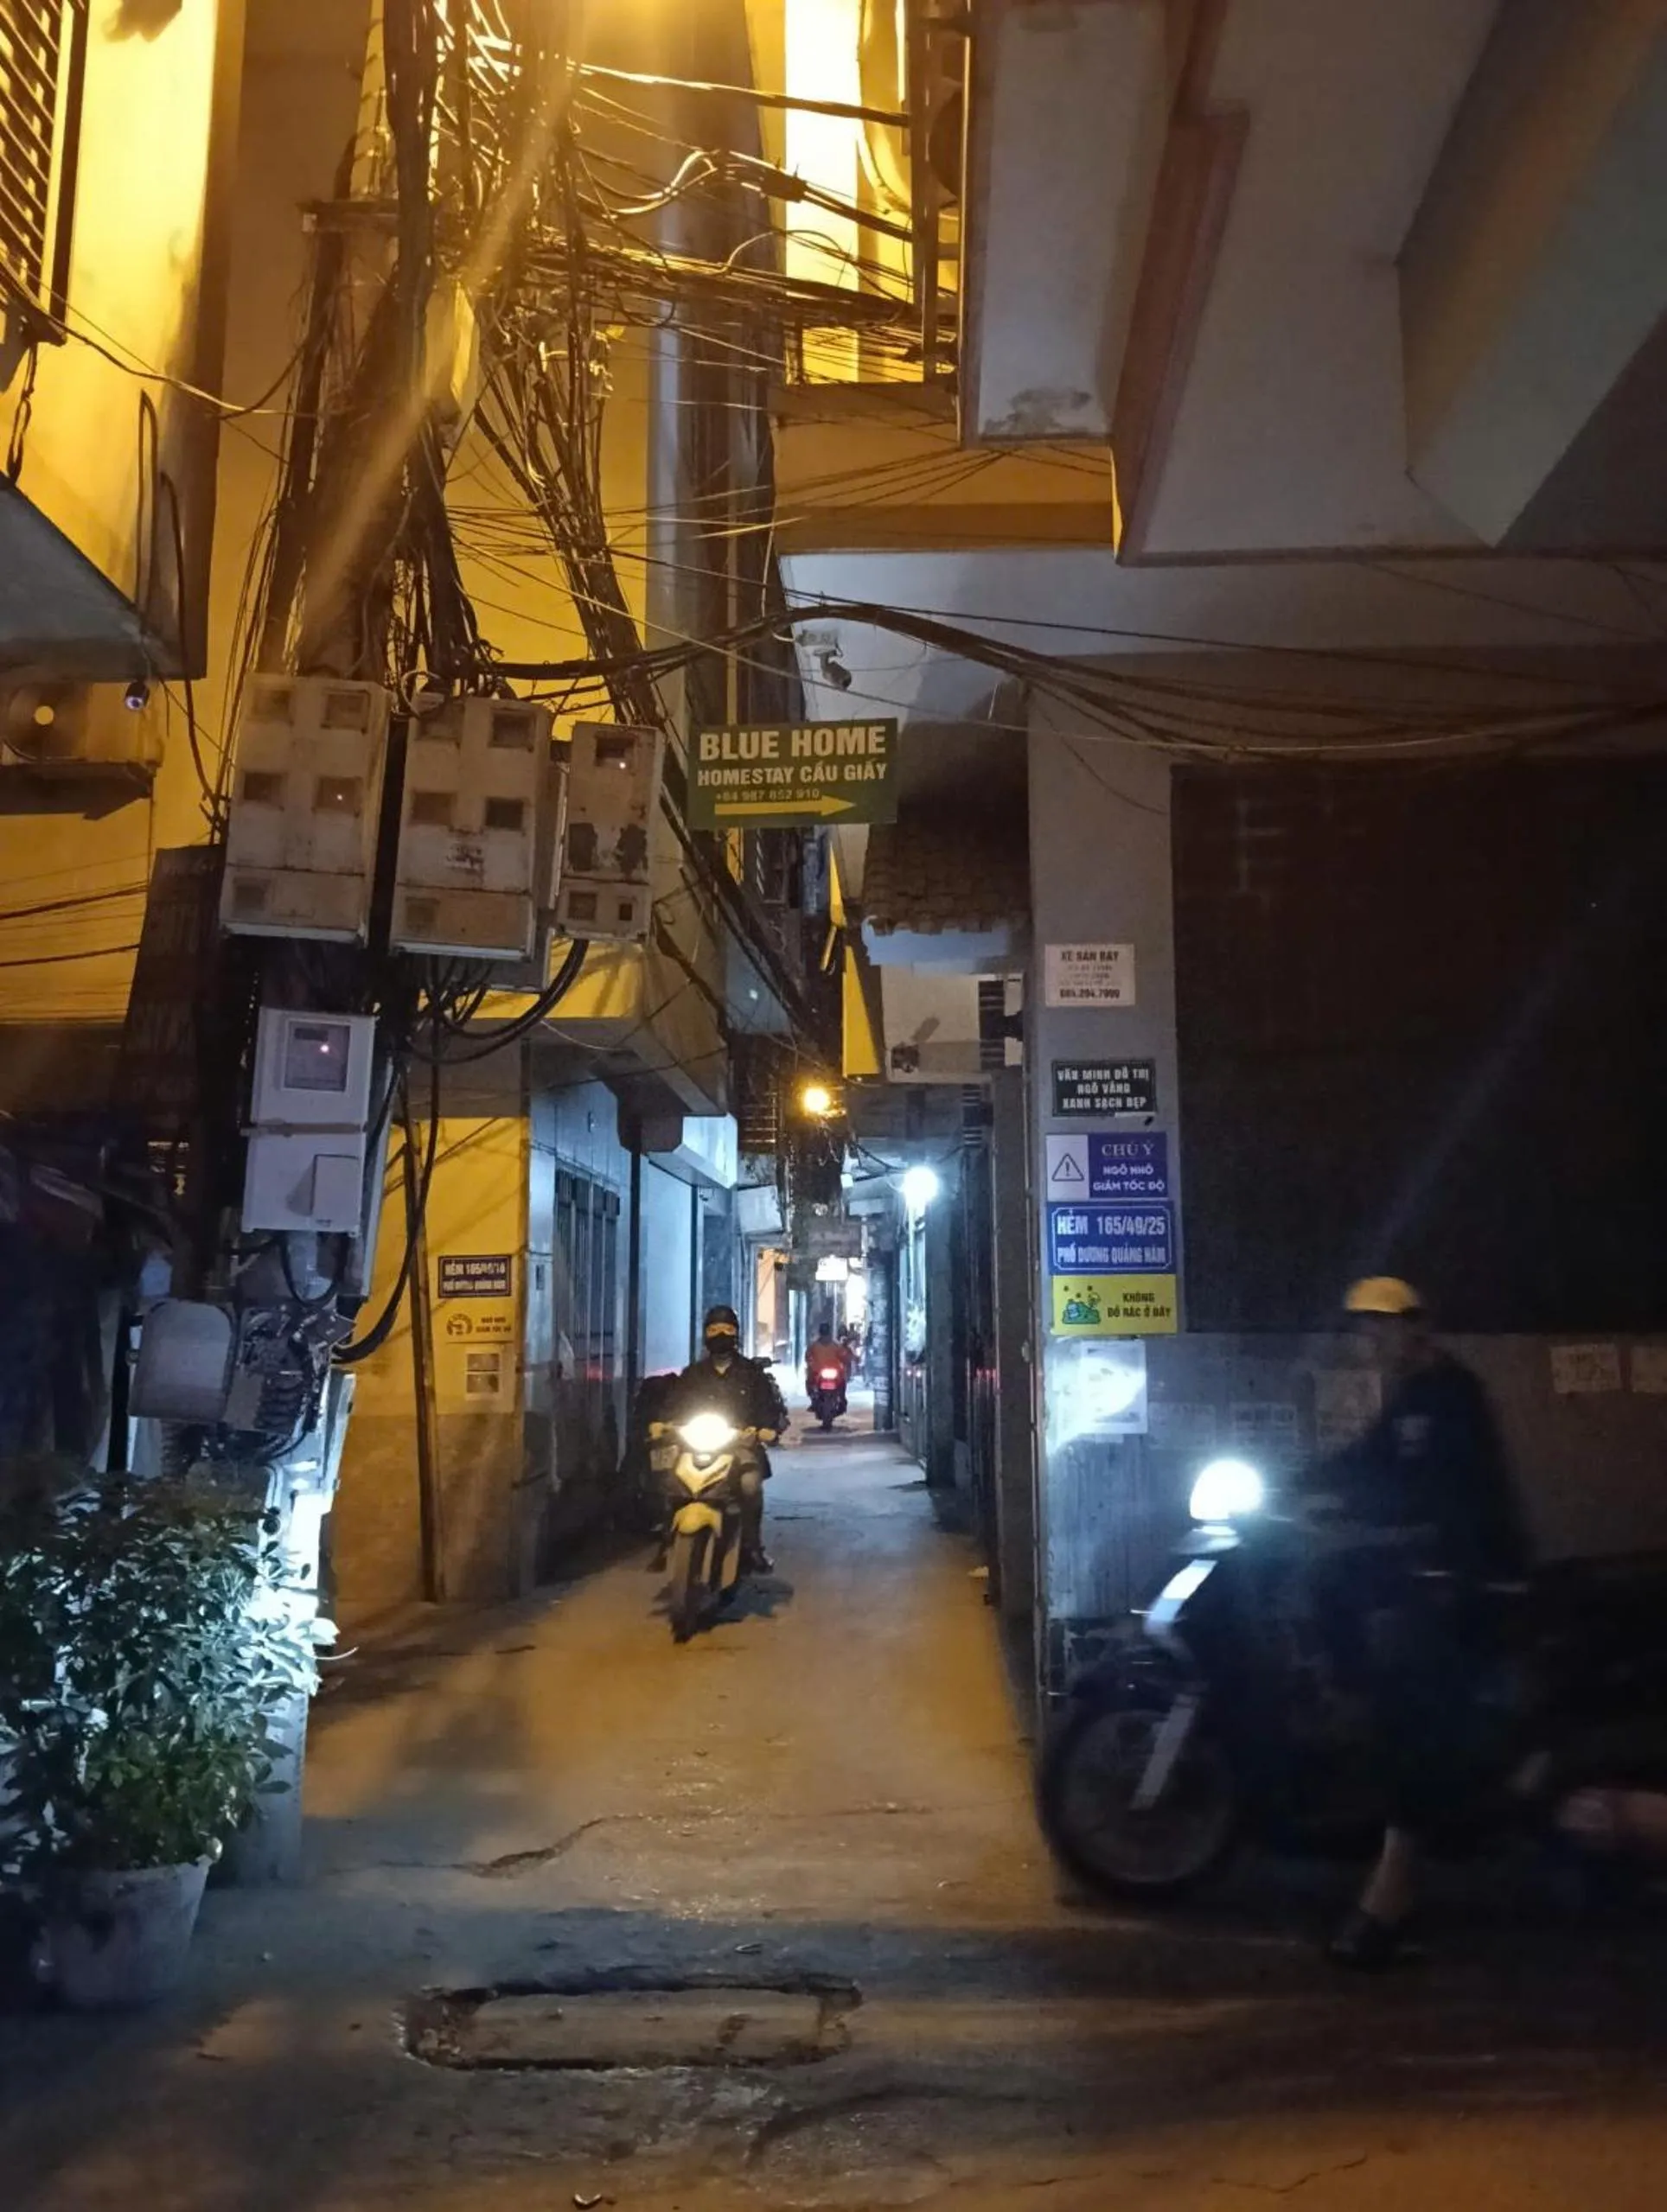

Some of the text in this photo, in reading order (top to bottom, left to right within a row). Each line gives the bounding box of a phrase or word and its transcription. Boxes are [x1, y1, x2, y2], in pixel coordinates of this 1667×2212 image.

[699, 725, 886, 762] BLUE HOME
[697, 765, 795, 787] HOMESTAY
[844, 757, 888, 781] GIẤY
[1083, 1069, 1111, 1081] MINH
[1063, 1098, 1091, 1108] XANH
[1095, 1098, 1123, 1110] SẠCH
[1102, 1141, 1139, 1157] CHÚ
[1123, 1178, 1146, 1190] TỐC
[1148, 1178, 1165, 1192] ĐỘ
